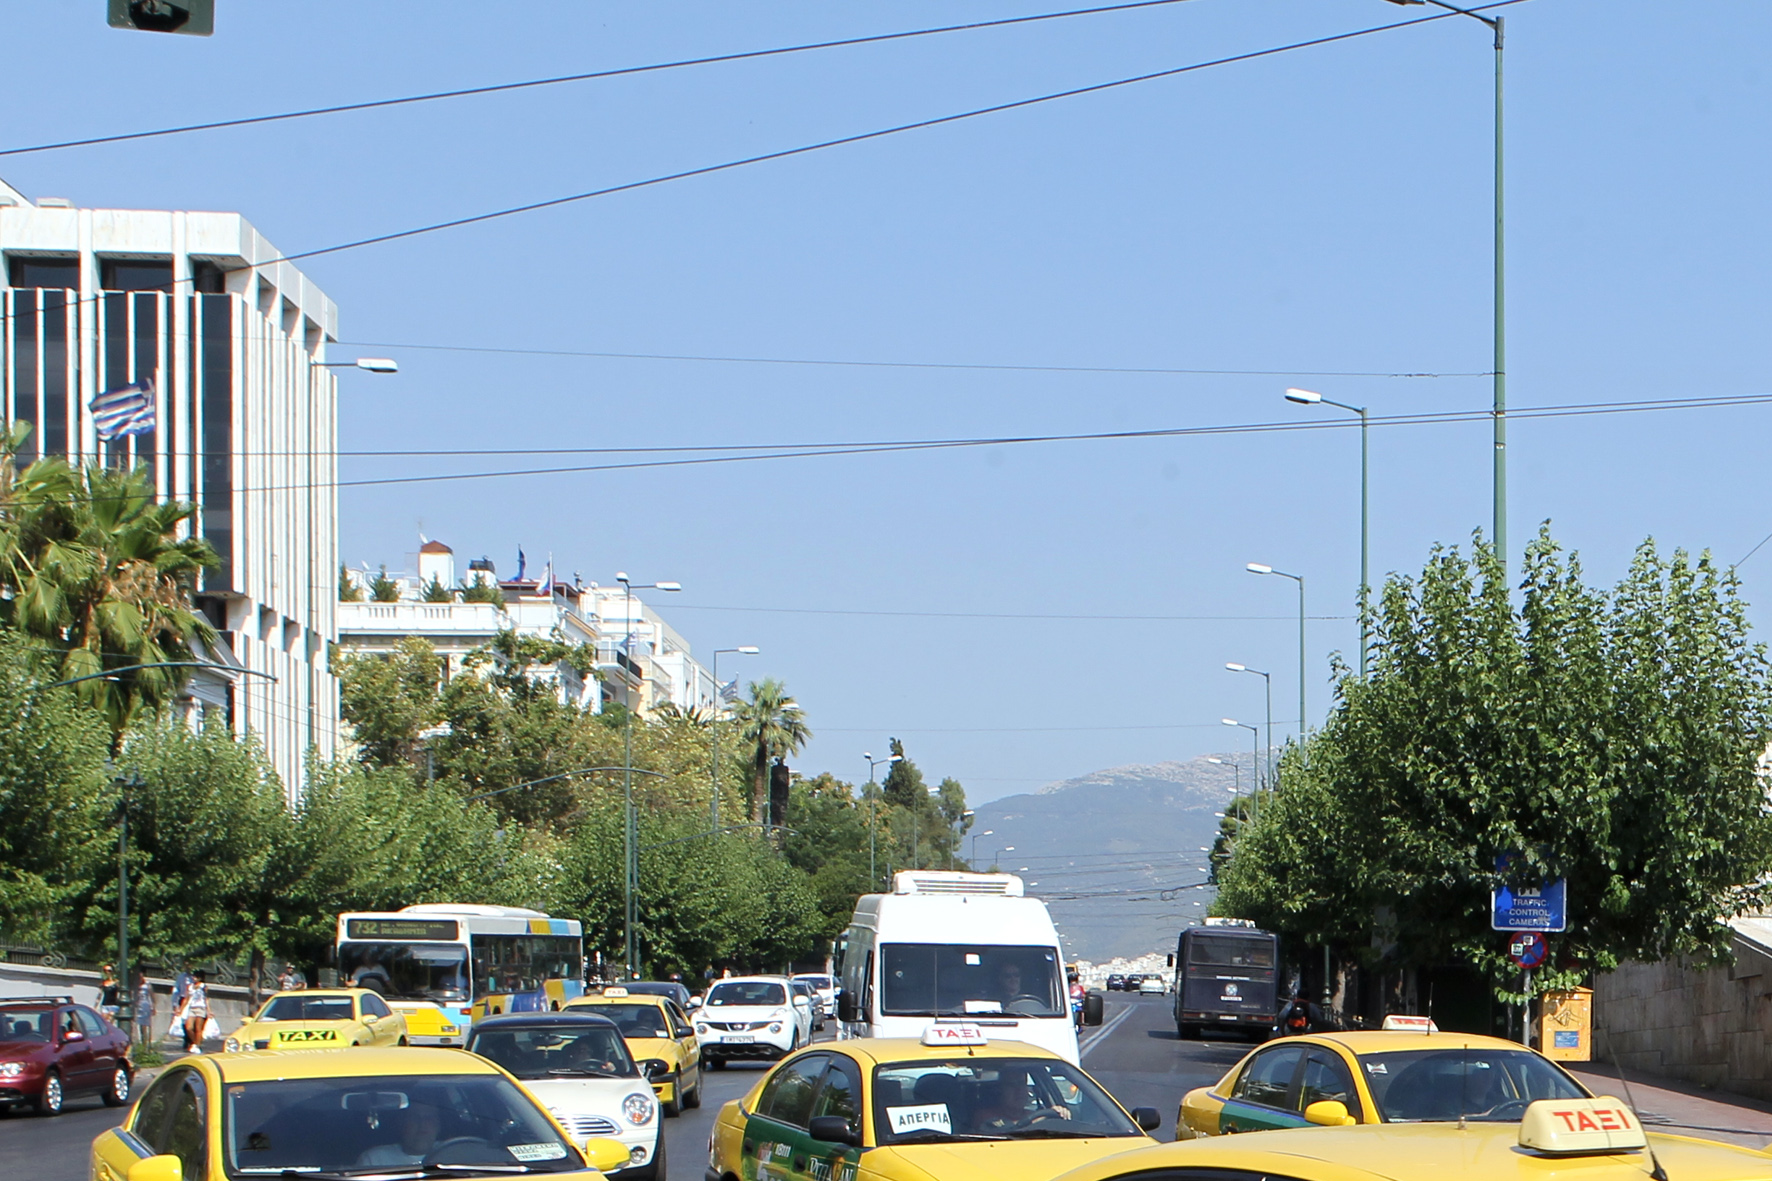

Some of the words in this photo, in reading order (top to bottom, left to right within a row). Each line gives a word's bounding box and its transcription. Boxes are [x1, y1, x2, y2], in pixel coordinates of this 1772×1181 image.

[1513, 898, 1547, 907] TRAFFIC
[1509, 908, 1551, 917] CONTROL
[355, 921, 378, 934] 732
[280, 1031, 336, 1042] TAXI
[932, 1029, 981, 1038] ΤΑΞΙ
[898, 1112, 950, 1126] ΑΠΕΡΓΙΑ
[1552, 1109, 1631, 1132] ΤΑΞΙ
